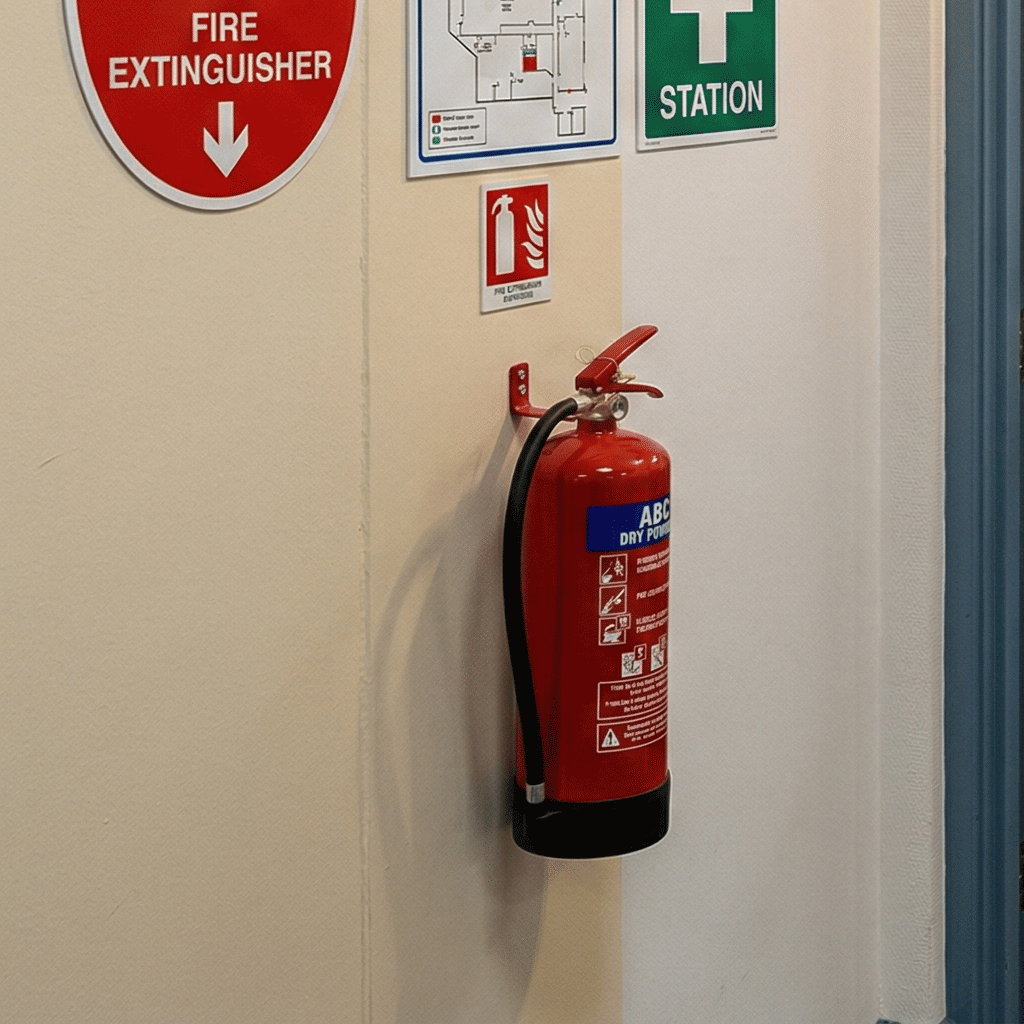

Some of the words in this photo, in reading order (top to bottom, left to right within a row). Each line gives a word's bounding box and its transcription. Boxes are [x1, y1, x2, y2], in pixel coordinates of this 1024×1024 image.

[192, 12, 258, 42] FIRE
[109, 50, 332, 89] EXTINGUISHER
[660, 80, 763, 120] STATION
[639, 498, 670, 529] ABC
[620, 529, 644, 546] DRY
